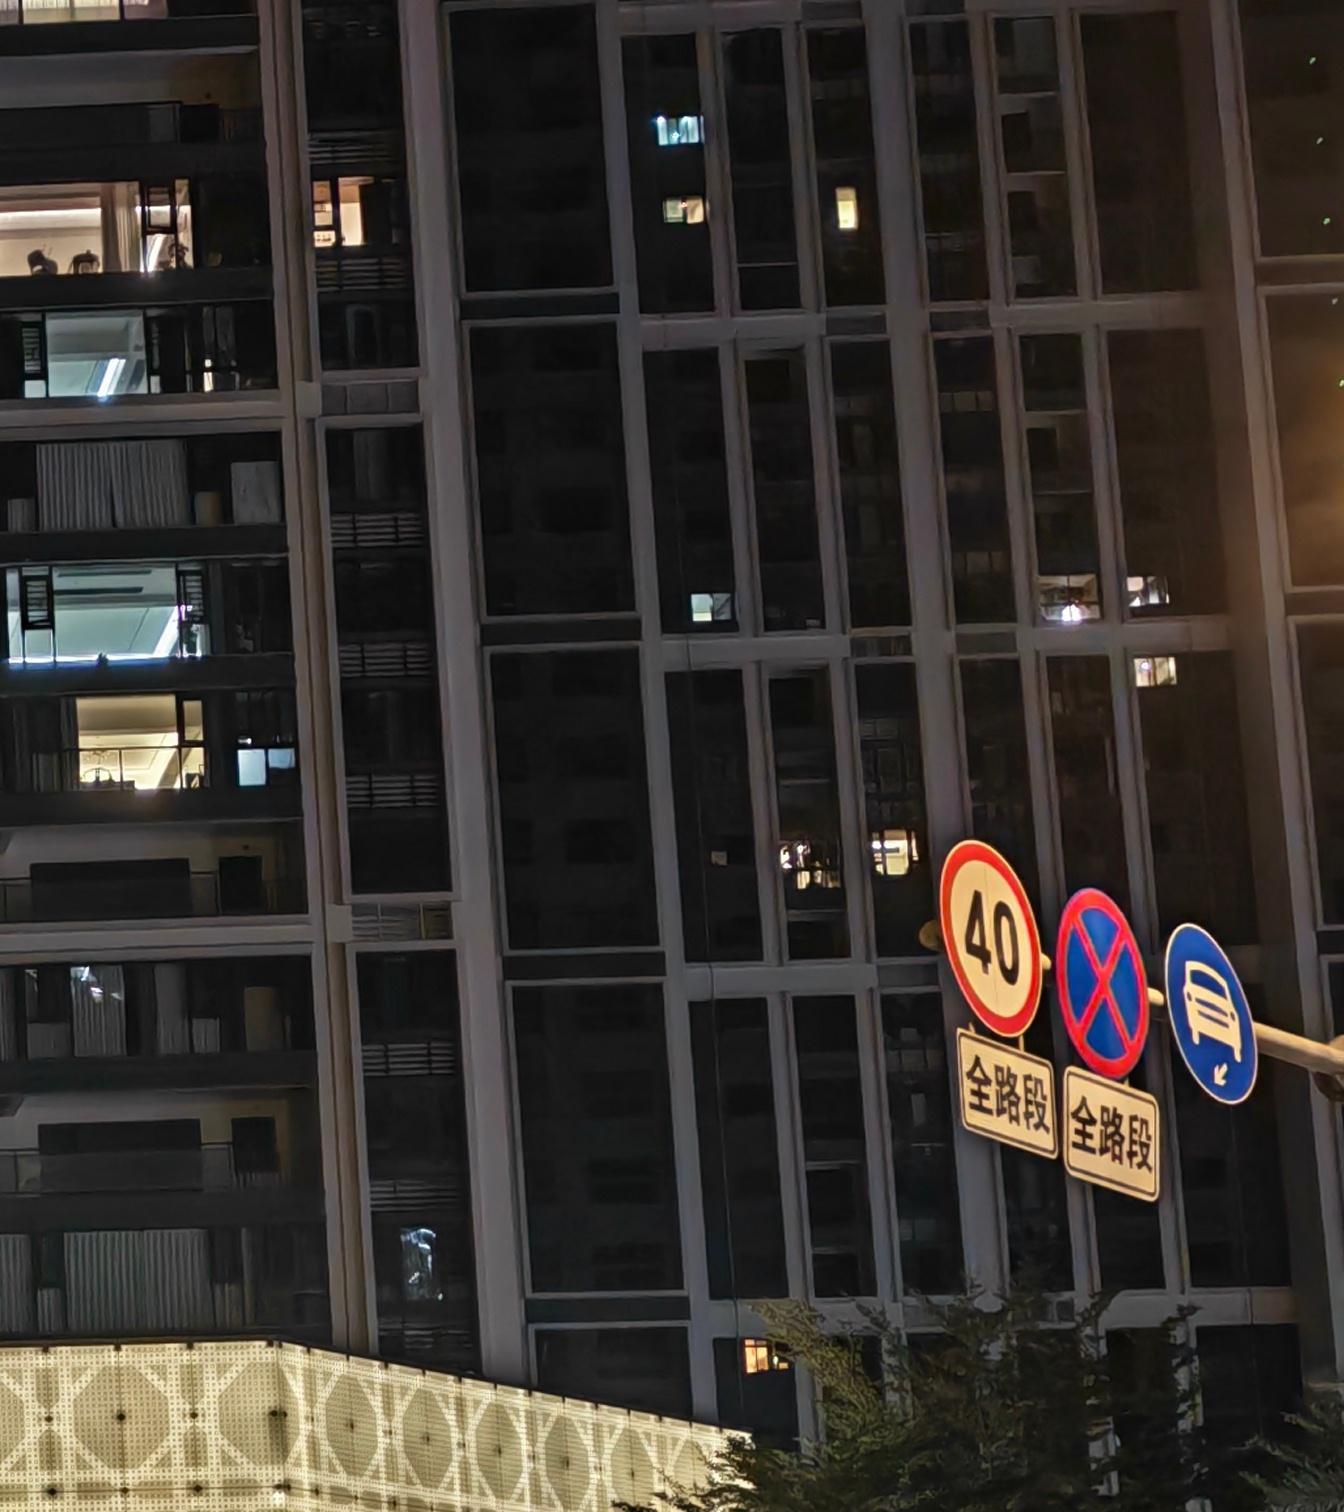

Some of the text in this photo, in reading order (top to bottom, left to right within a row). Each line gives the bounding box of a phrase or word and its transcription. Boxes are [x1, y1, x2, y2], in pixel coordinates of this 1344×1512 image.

[965, 889, 1019, 986] 40
[966, 1055, 1051, 1136] 全路段
[1070, 1095, 1154, 1174] 全路段
